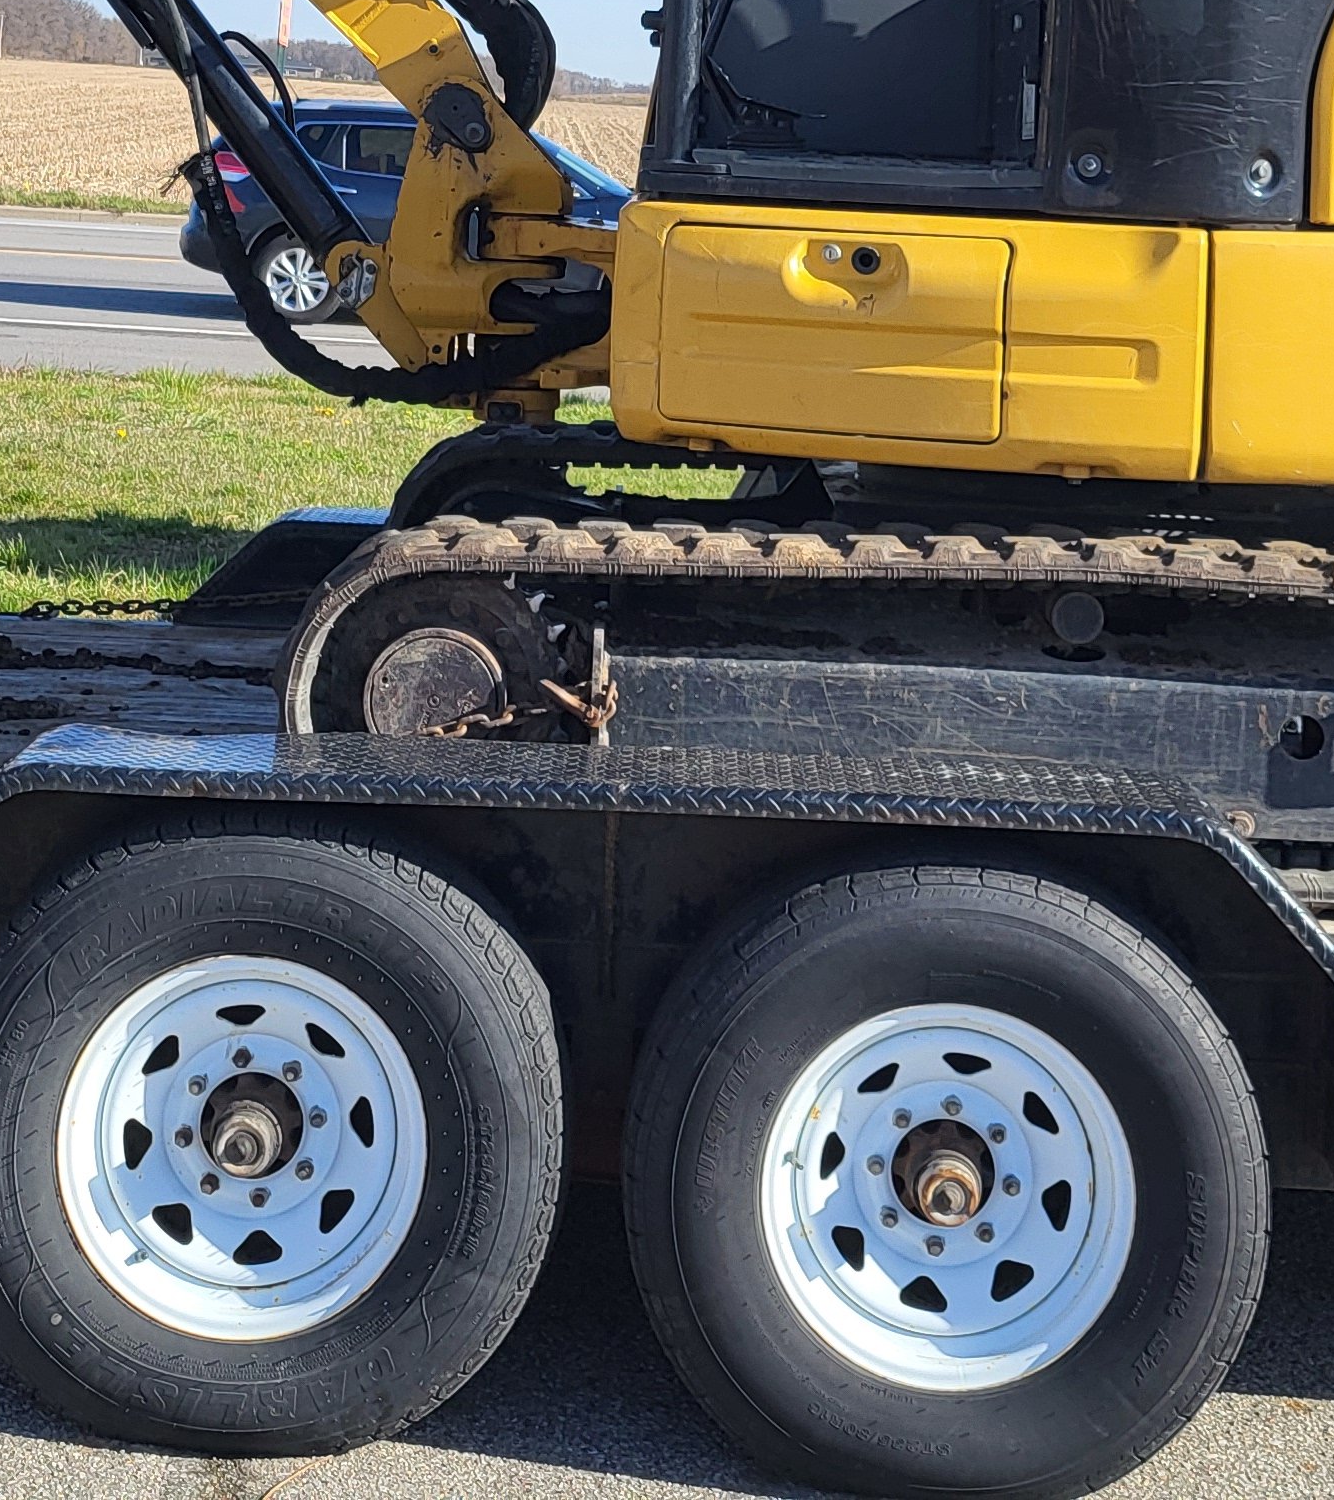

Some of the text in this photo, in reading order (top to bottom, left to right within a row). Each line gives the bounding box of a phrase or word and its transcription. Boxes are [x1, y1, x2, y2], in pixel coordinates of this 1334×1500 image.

[70, 883, 273, 977] RADIAL
[695, 1037, 765, 1191] WESTLAKE
[1166, 1171, 1208, 1319] SUPER
[54, 1327, 408, 1427] CARLISLE
[1130, 1327, 1172, 1388] ST
